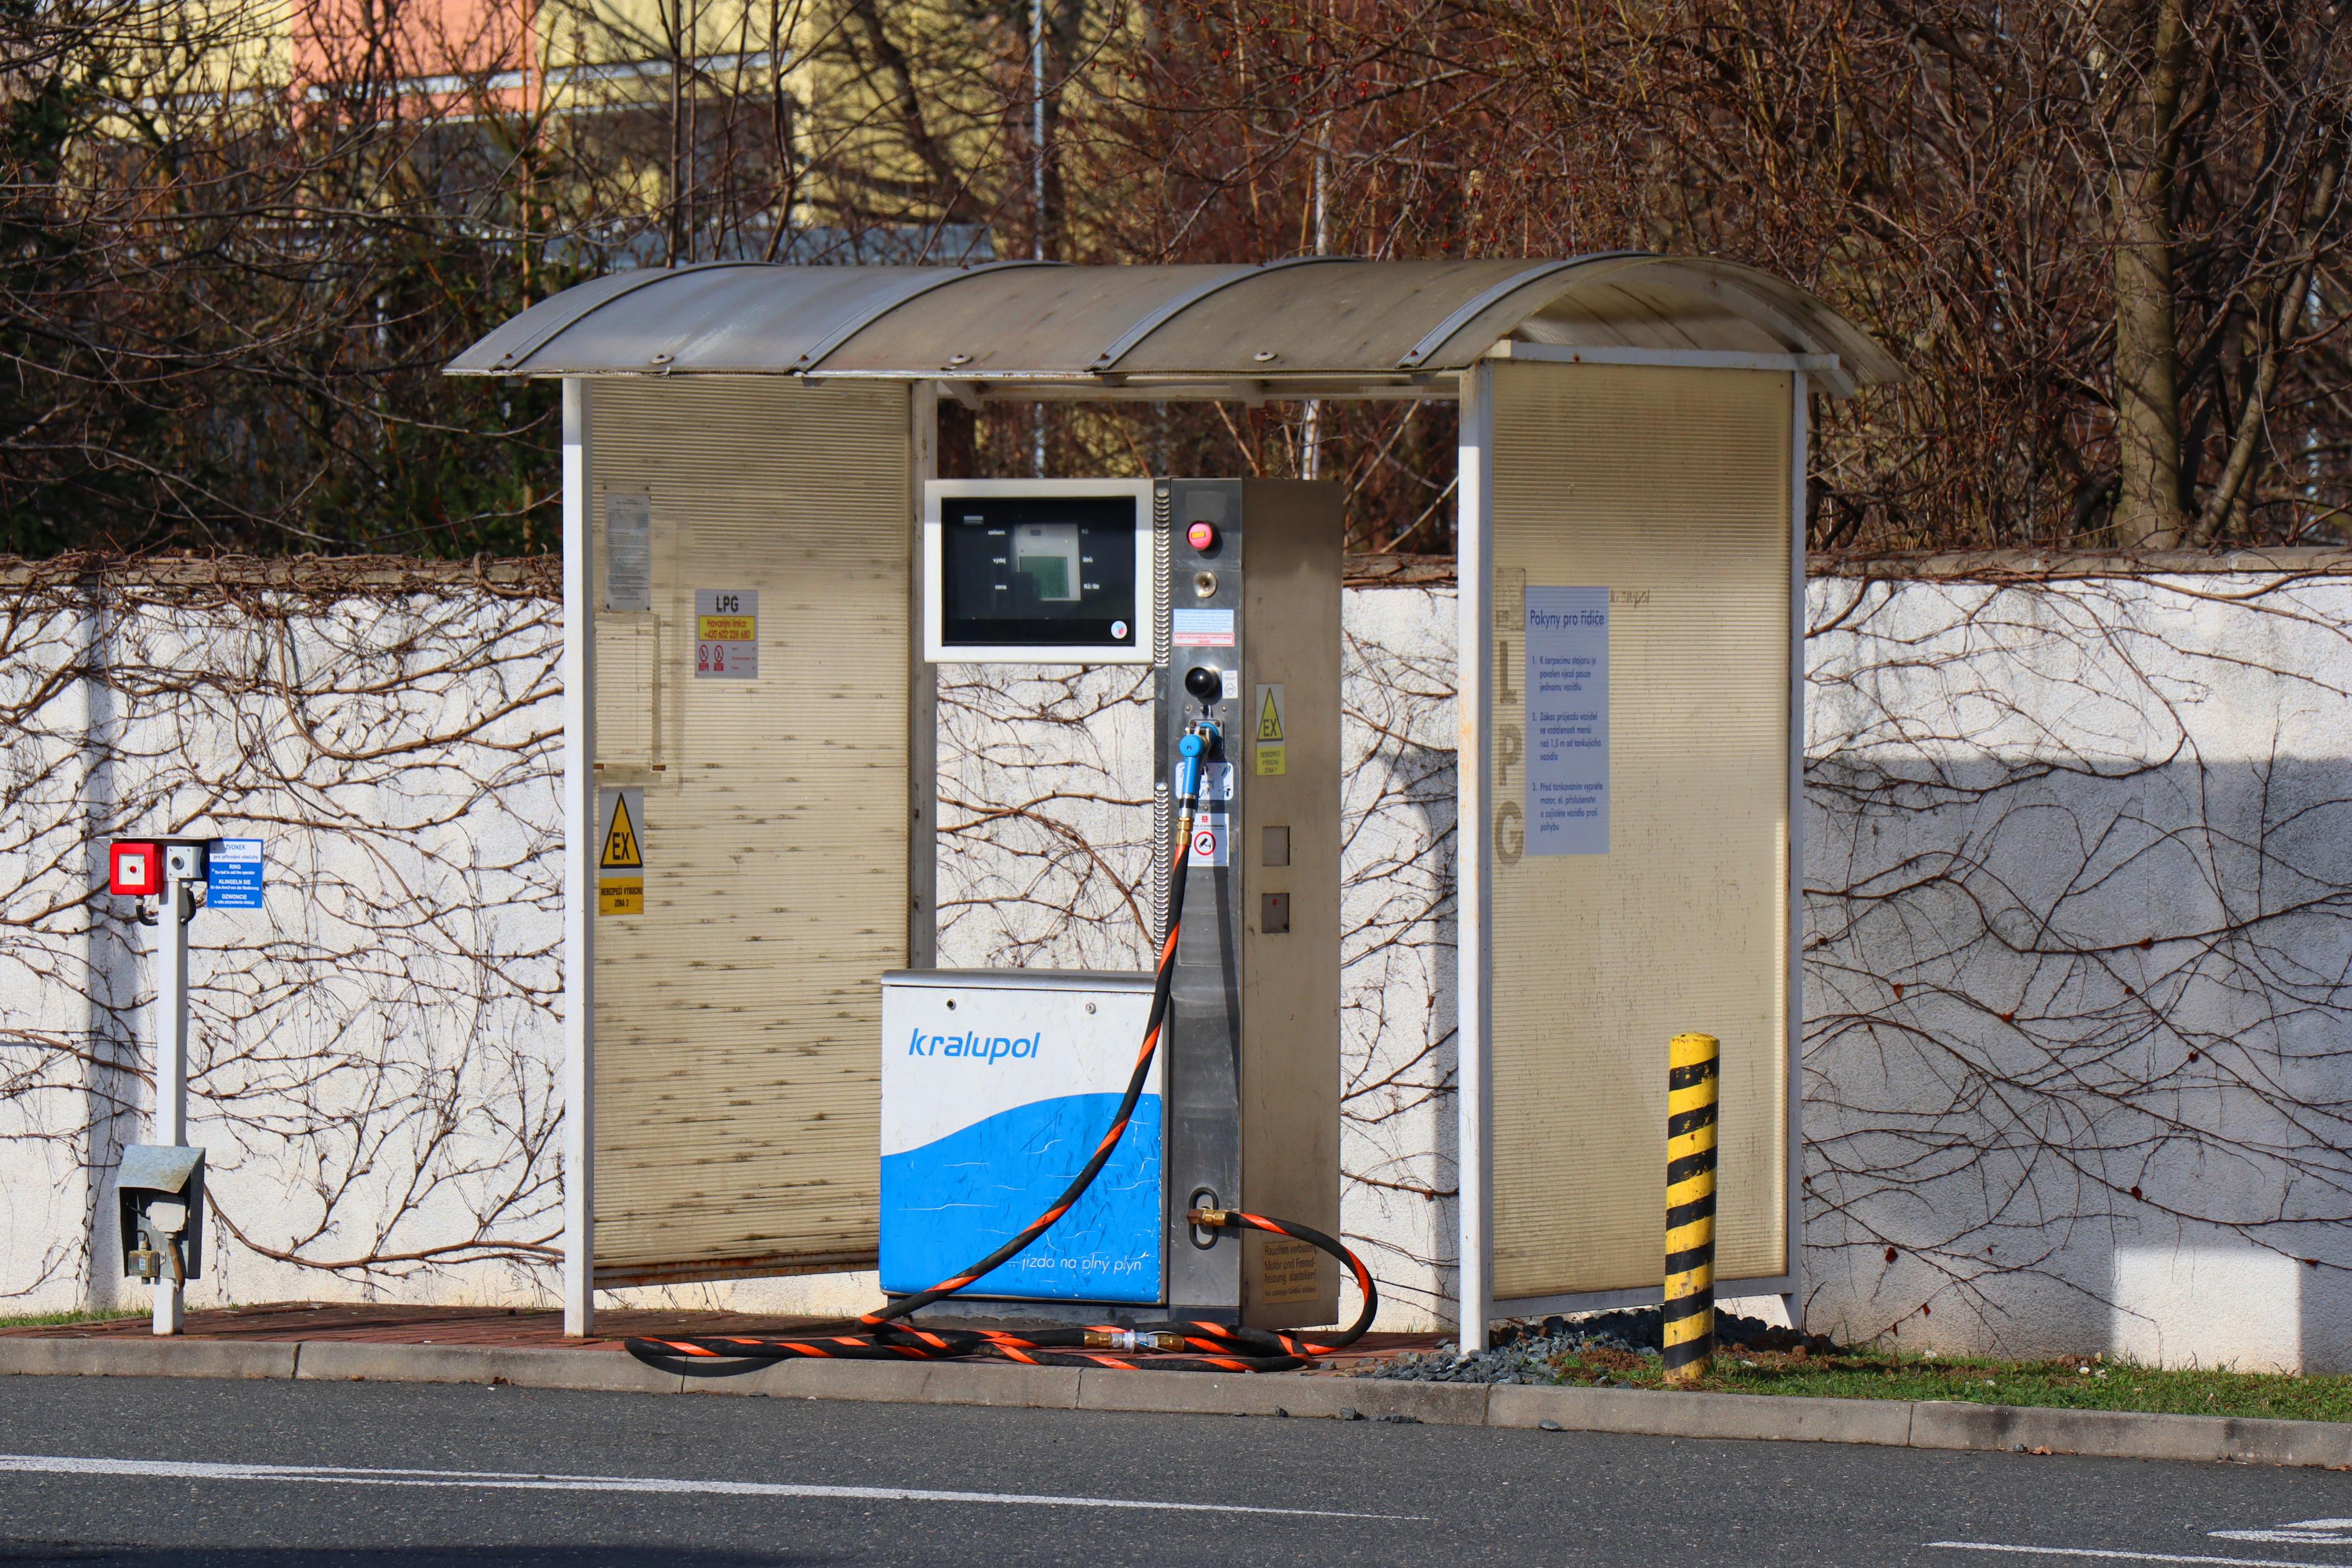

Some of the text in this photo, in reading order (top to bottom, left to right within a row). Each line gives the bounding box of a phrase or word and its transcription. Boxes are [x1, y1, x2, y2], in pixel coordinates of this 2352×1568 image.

[716, 595, 739, 613] LPG
[1610, 589, 1650, 608] klupol
[1530, 610, 1604, 629] Pokyny pro řidiče
[719, 630, 727, 638] 602
[1532, 655, 1596, 666] 1. K čerpacímu stojanu je
[1539, 669, 1591, 679] povolen vjezd pouze
[1539, 682, 1581, 693] jednomu vozidlu
[1532, 712, 1598, 723] 2. Zákaz průjezdu vozidel
[1264, 719, 1277, 736] EX
[1547, 725, 1575, 734] vzdálenosti
[1577, 725, 1591, 734] menší
[1540, 739, 1549, 747] než
[1566, 738, 1572, 747] od
[1574, 738, 1601, 749] tankujícího
[1540, 751, 1558, 760] vozidla
[1532, 782, 1603, 792] 3. Před tankováním vypněte
[1540, 796, 1556, 805] motor,
[1566, 795, 1596, 806] příslušenství
[1545, 808, 1566, 819] zajistěte
[1567, 808, 1585, 817] vozidlo
[1586, 808, 1598, 819] proti
[1540, 821, 1559, 833] pohybu
[613, 832, 630, 860] EX
[601, 884, 643, 896] NEBEZPEČÍ VÝBUCHU
[615, 897, 629, 907] ZÓNA 2
[908, 1028, 1041, 1065] kralupol
[1264, 1245, 1289, 1256] Rauchen
[1060, 1258, 1077, 1269] na
[1082, 1254, 1109, 1274] plný
[1113, 1255, 1142, 1275] plyn
[1264, 1257, 1315, 1271] Motor und Fremd-
[1264, 1269, 1316, 1284] heizung abstellen!
